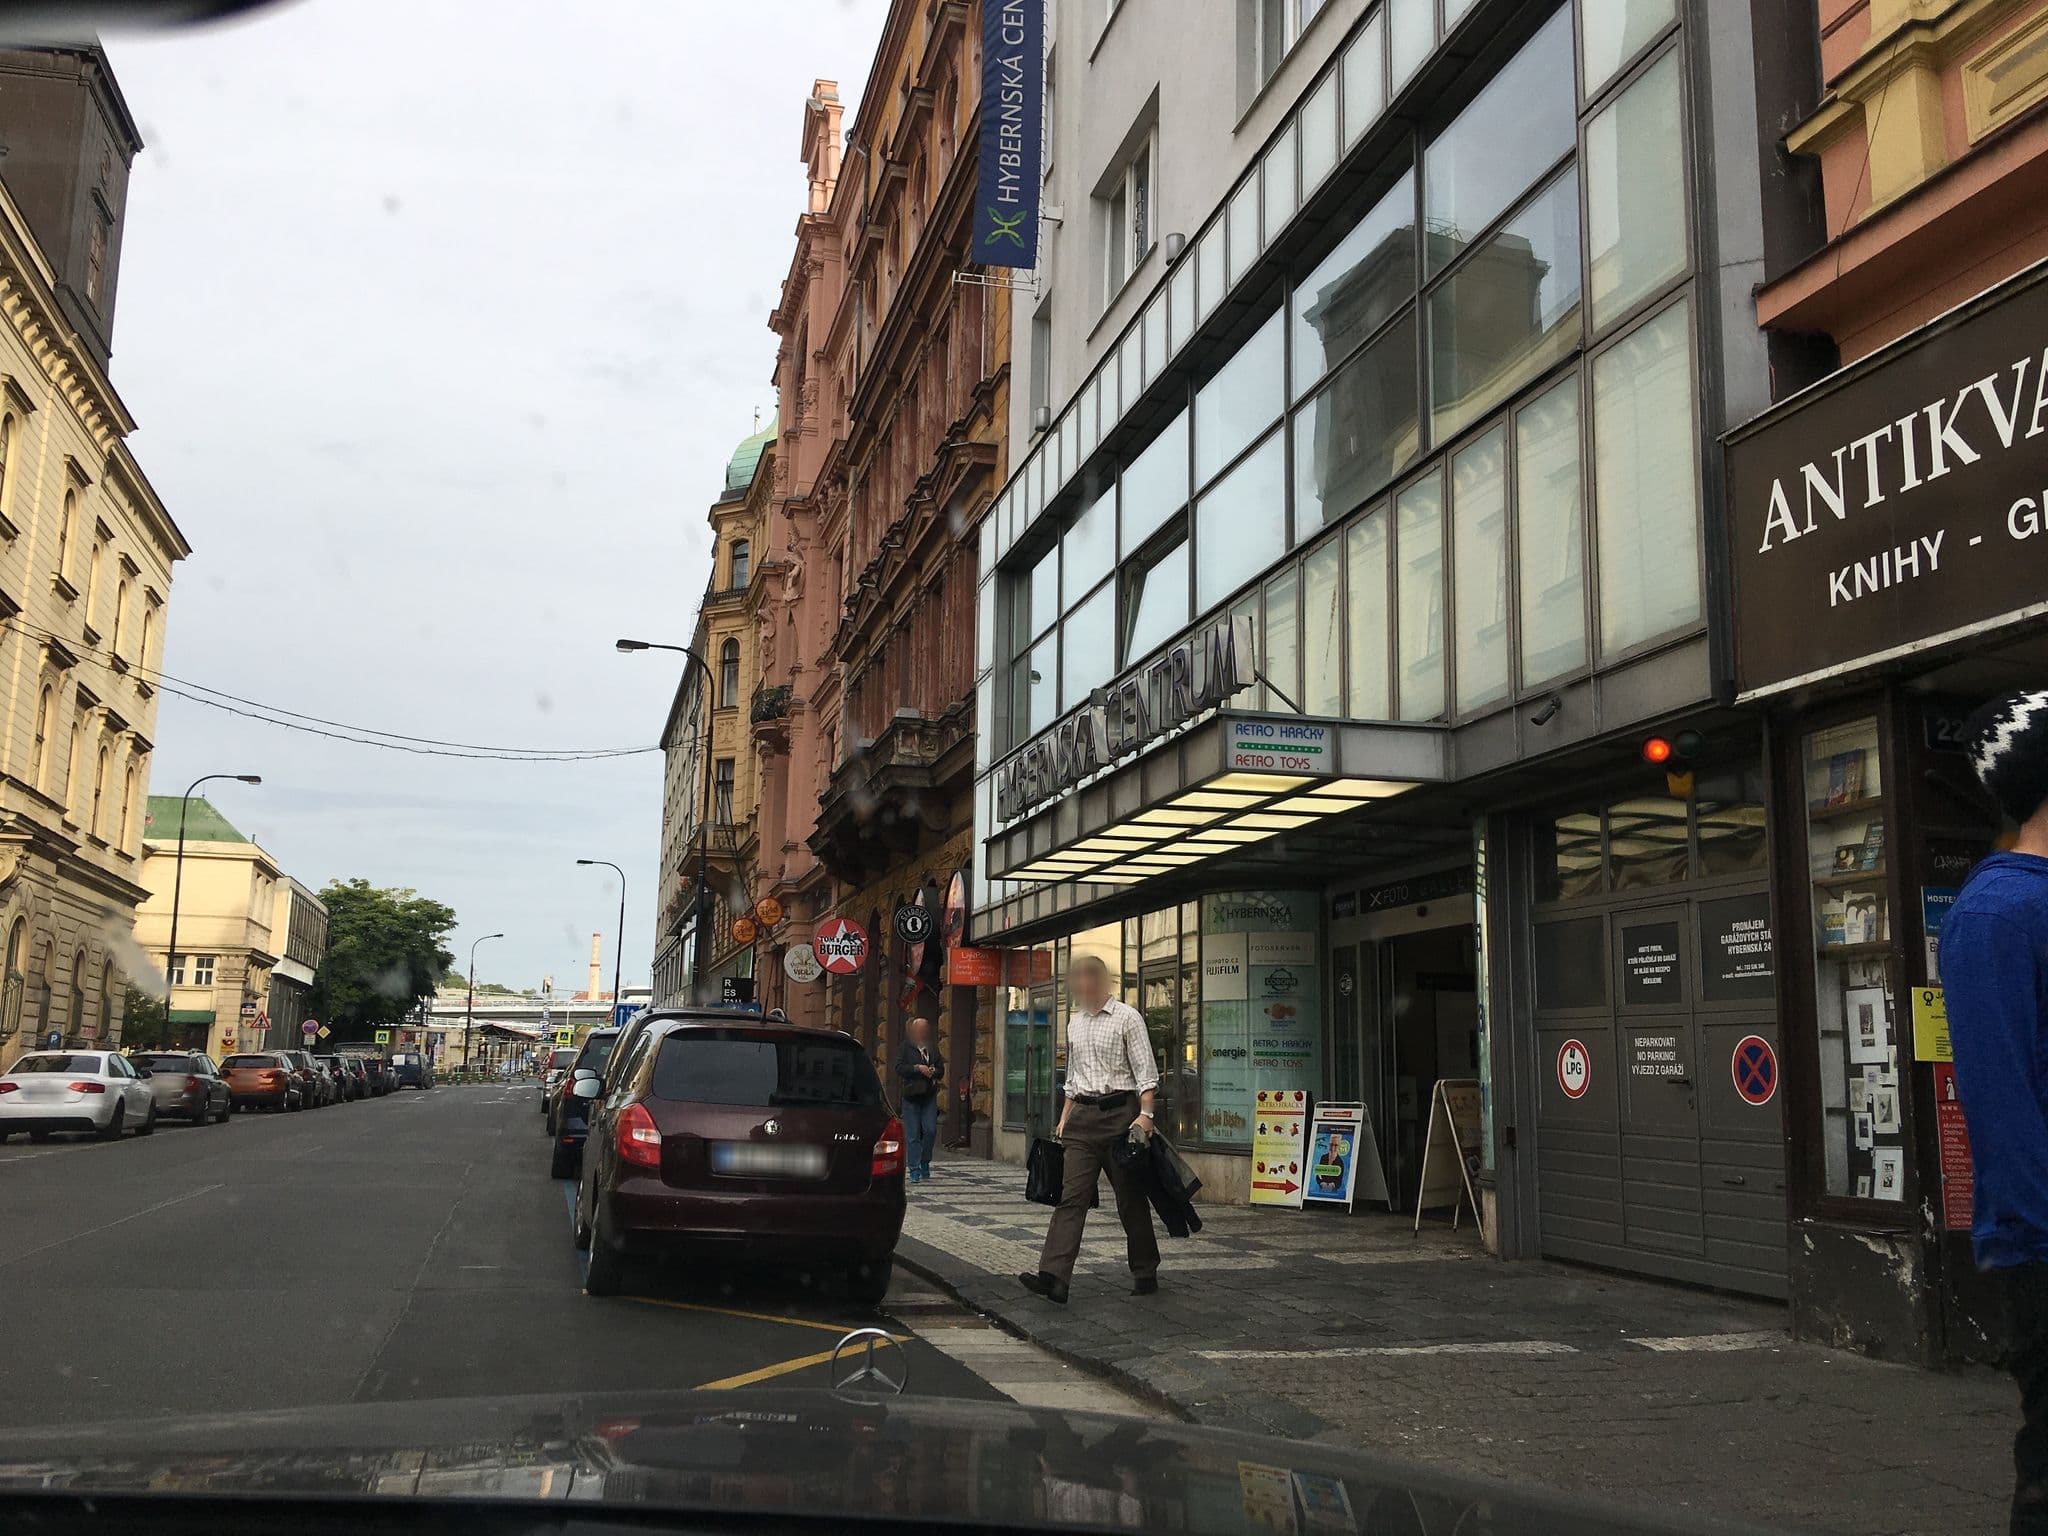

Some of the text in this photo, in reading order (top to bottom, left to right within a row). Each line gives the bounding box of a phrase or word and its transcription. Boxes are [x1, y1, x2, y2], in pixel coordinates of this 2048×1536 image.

[996, 54, 1024, 203] HYBERNSKÁ
[1828, 529, 1945, 607] KNIHY
[1105, 615, 1256, 757] CENTRUM
[1236, 722, 1324, 740] RETRO HRAČKY
[1236, 755, 1310, 769] RETRO TOYS
[1927, 895, 1956, 903] HOSTE
[1732, 918, 1764, 932] PRONÁJEM
[1720, 931, 1759, 945] GARÁŽOVÝCH
[819, 944, 864, 956] BURGER
[1727, 941, 1772, 955] HYBERNSKÁ 24
[1635, 1037, 1675, 1047] NEPARKOVAT!
[1212, 1047, 1246, 1059] energie
[1637, 1050, 1676, 1061] NO PARKING!
[1566, 1062, 1582, 1075] LPG
[1632, 1063, 1684, 1075] VÝJEZD Z GARÁŽÍ
